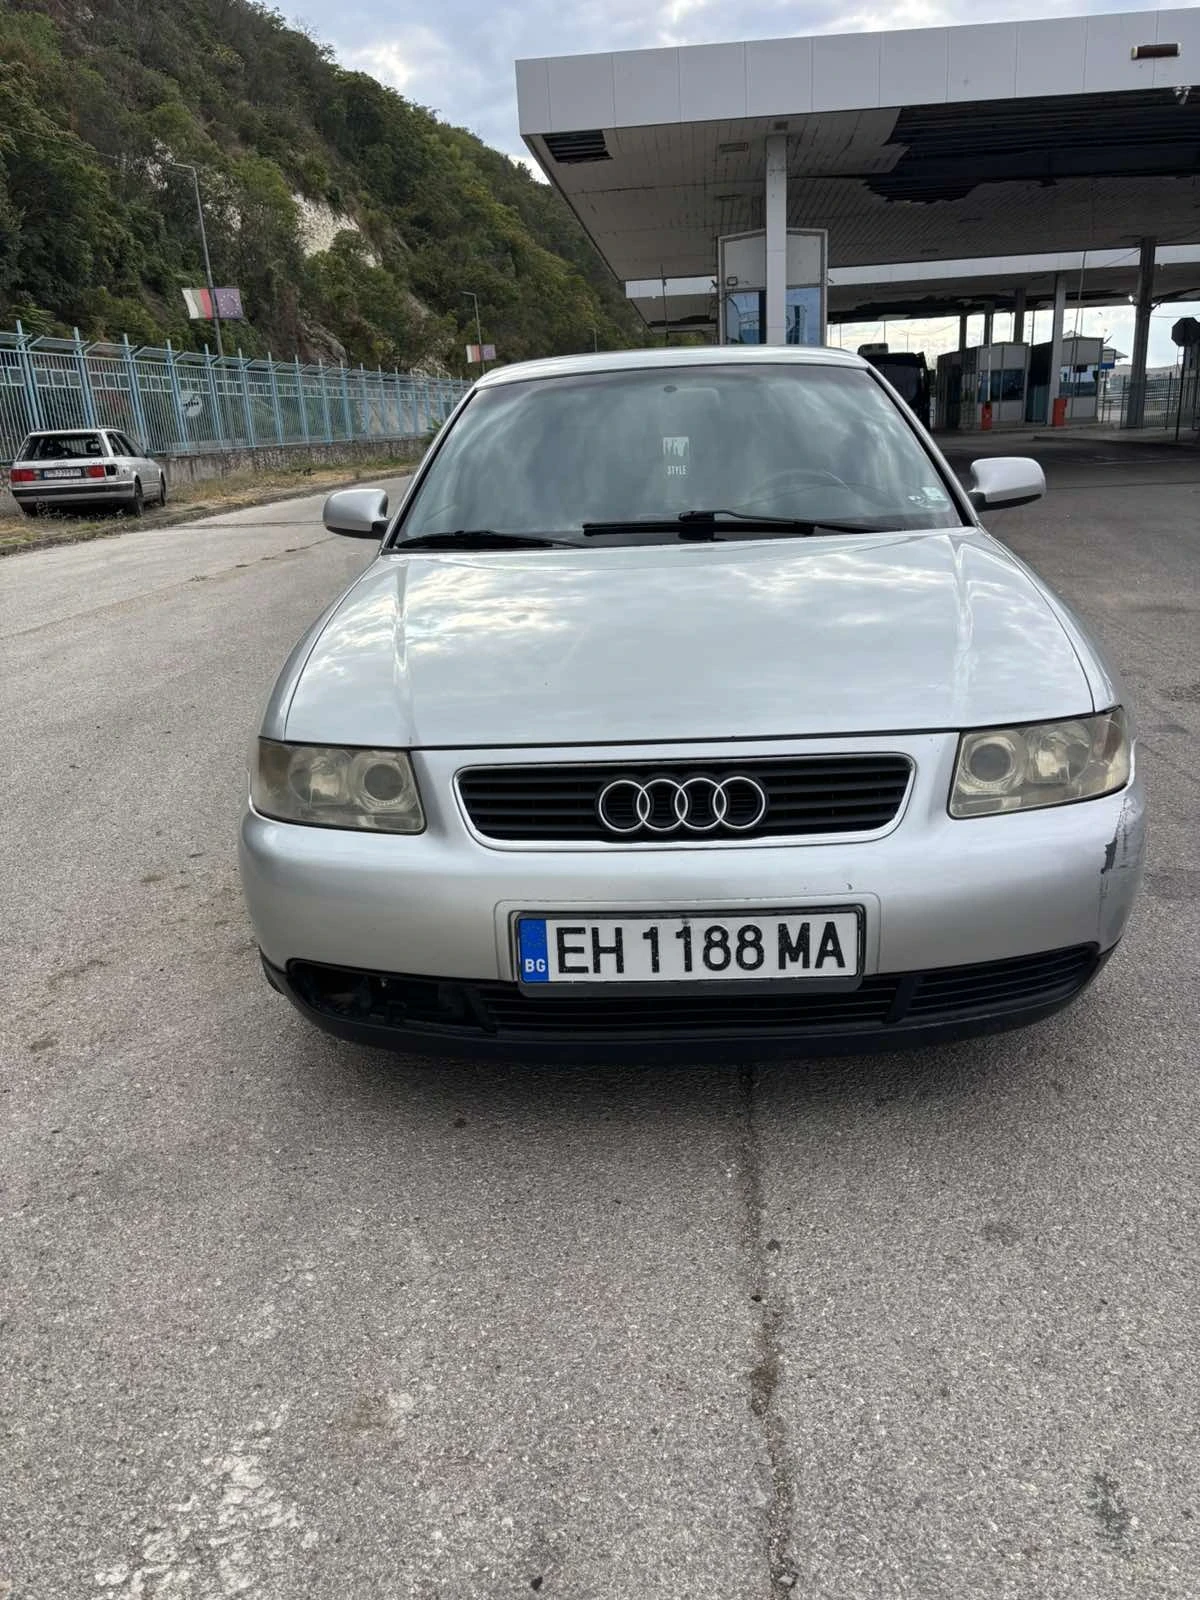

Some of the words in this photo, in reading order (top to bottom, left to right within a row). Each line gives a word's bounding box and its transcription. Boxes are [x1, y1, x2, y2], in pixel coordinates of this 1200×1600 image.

[524, 958, 546, 973] BG
[556, 926, 625, 974] EH
[642, 923, 765, 974] 1188
[778, 922, 846, 970] MA
